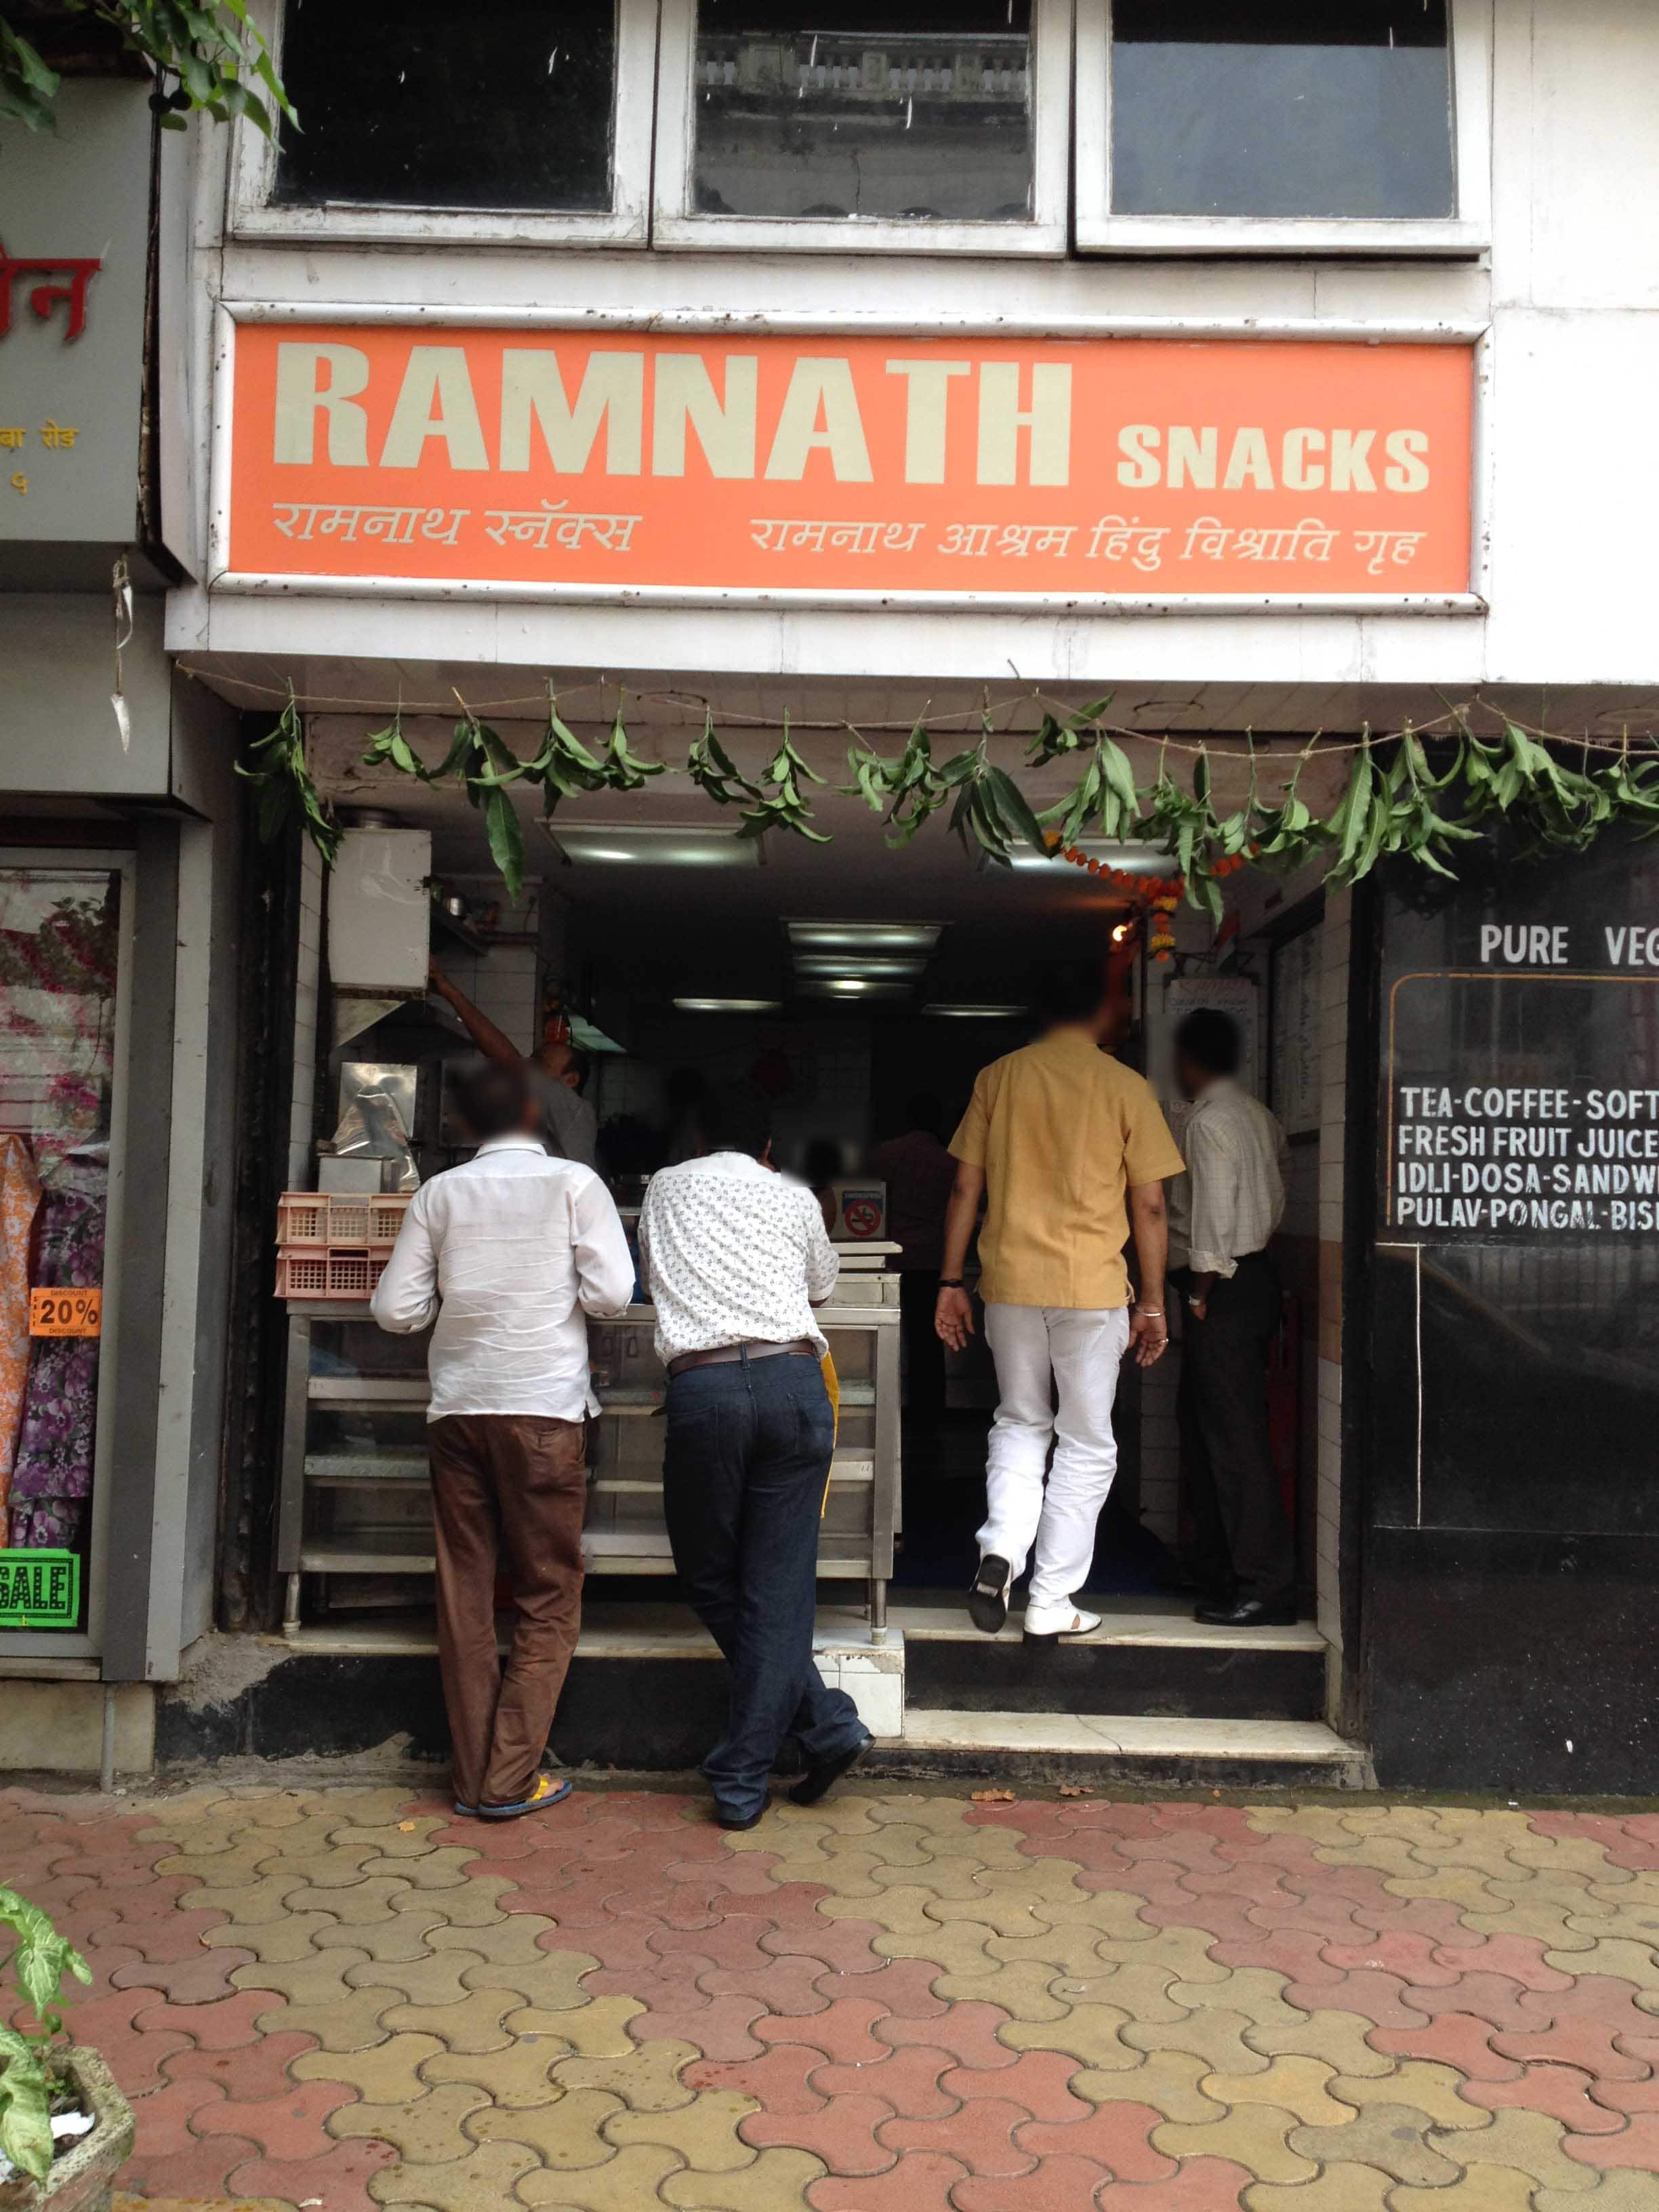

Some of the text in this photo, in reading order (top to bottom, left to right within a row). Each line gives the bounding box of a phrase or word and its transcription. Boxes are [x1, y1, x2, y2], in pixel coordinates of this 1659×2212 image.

[274, 342, 1430, 493] RAMNATH SNACKS
[273, 503, 470, 546] रामनाथ
[750, 519, 926, 553] रामनाथ
[938, 523, 1078, 558] आश्रम
[1086, 515, 1171, 571] हिंदु
[1354, 531, 1428, 575] गृह
[1481, 924, 1569, 964] PURE
[1399, 1125, 1658, 1158] FRESH FRUIT JUICE
[40, 1299, 98, 1325] 20%
